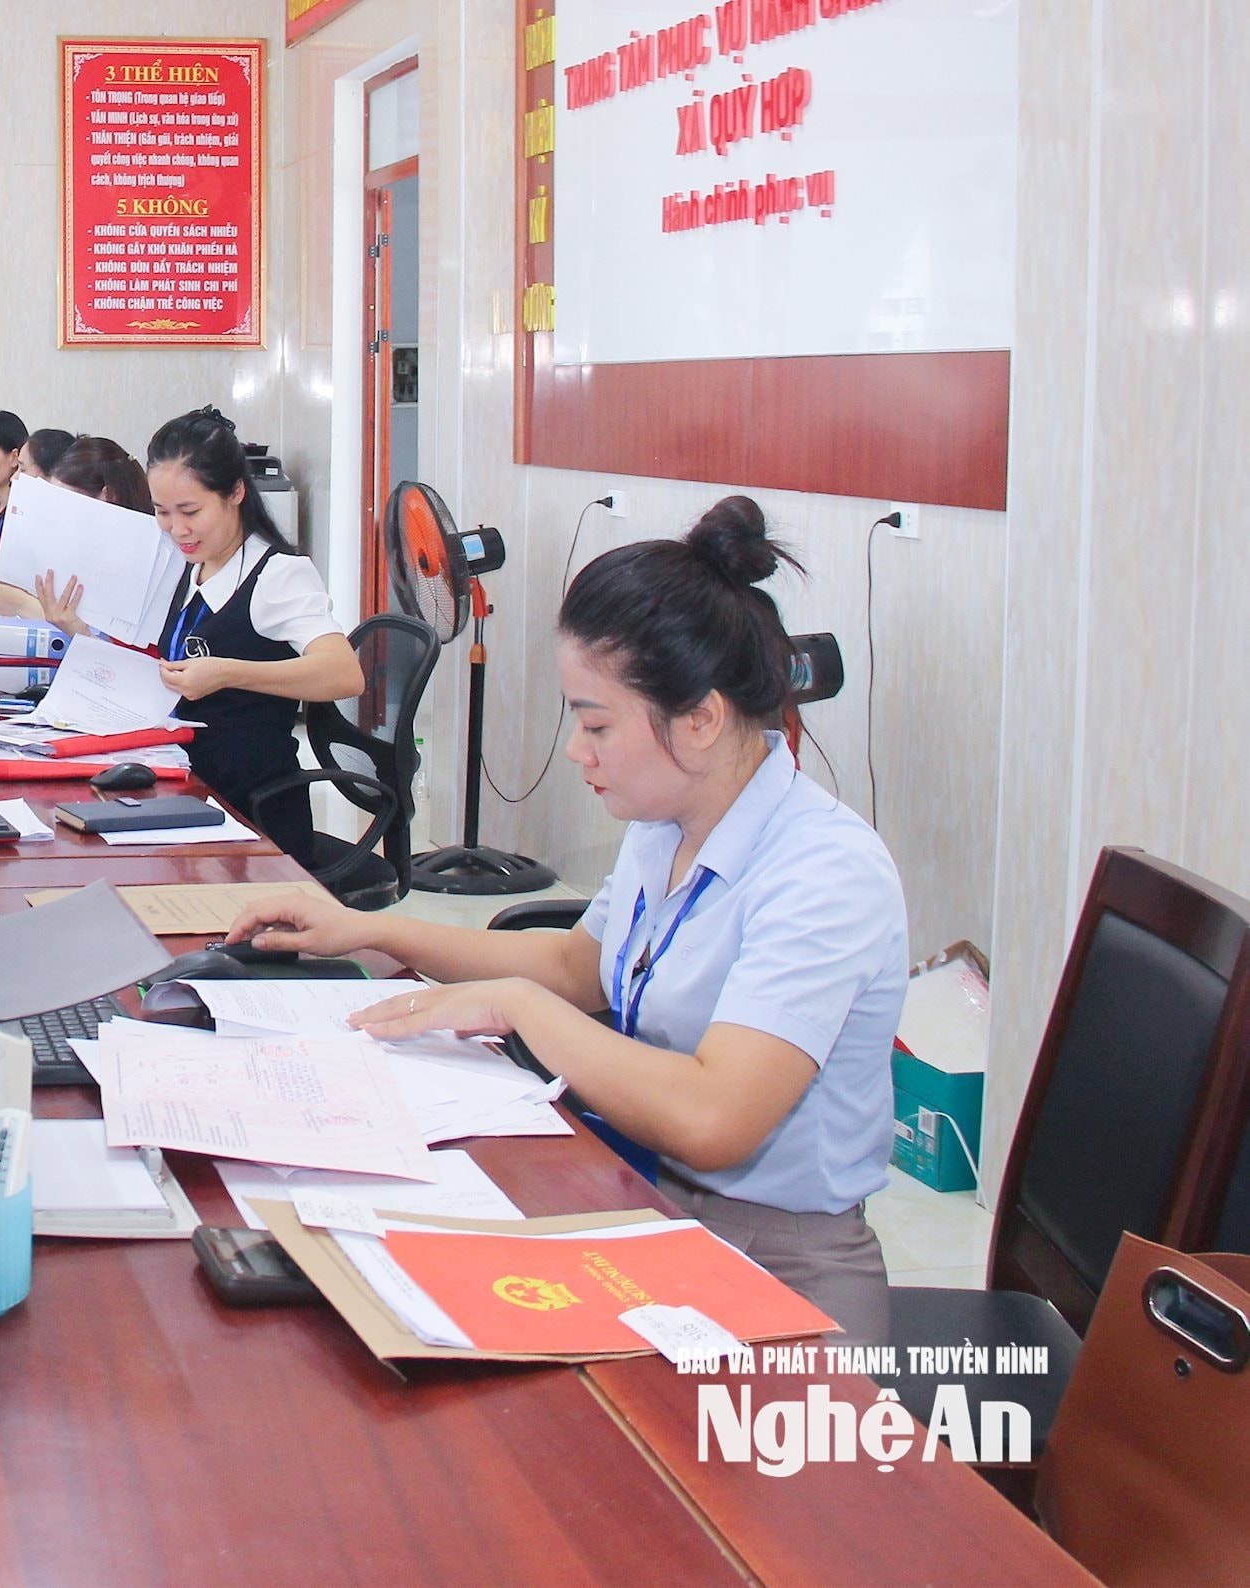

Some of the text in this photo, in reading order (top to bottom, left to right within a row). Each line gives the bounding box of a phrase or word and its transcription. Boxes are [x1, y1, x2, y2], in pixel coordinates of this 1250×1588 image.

[565, 52, 616, 109] TRUNG
[617, 31, 654, 91] TÂM
[658, 15, 711, 80] PHỤC
[716, 0, 748, 63] VỤ
[105, 59, 219, 86] 3 THỂ HIỆN
[91, 89, 225, 107] TÔN TRỌNG (Trong quan hệ giao tiếp)
[108, 112, 127, 124] MINH
[129, 112, 147, 126] (Lịch
[191, 113, 210, 126] trong
[676, 90, 707, 155] XÃ
[114, 130, 136, 147] THIỆN
[174, 134, 194, 145] trách
[196, 134, 222, 148] nhiệm,
[91, 150, 111, 166] quyết
[132, 153, 147, 167] việc
[148, 154, 170, 165] nhanh
[221, 155, 238, 166] quan
[91, 173, 112, 186] cách,
[117, 195, 208, 215] 5 KHÔNG
[662, 171, 834, 232] Hành chính phục vụ
[95, 223, 125, 236] KHÔNG
[183, 224, 207, 237] SÁCH
[94, 241, 125, 254] KHÔNG
[128, 241, 145, 254] GÂY
[148, 242, 165, 254] KHÓ
[225, 242, 238, 255] HÀ
[96, 260, 126, 273] KHÔNG
[175, 260, 204, 273] TRÁCH
[208, 260, 238, 275] NHIỆM
[95, 278, 126, 291] KHÔNG
[130, 278, 149, 291] LÀM
[152, 278, 175, 291] PHÁT
[179, 281, 200, 291] SINH
[204, 281, 218, 291] CHI
[94, 296, 125, 309] KHÔNG
[128, 296, 154, 312] CHẬM
[176, 297, 200, 310] CÔNG
[203, 297, 223, 312] VIỆC
